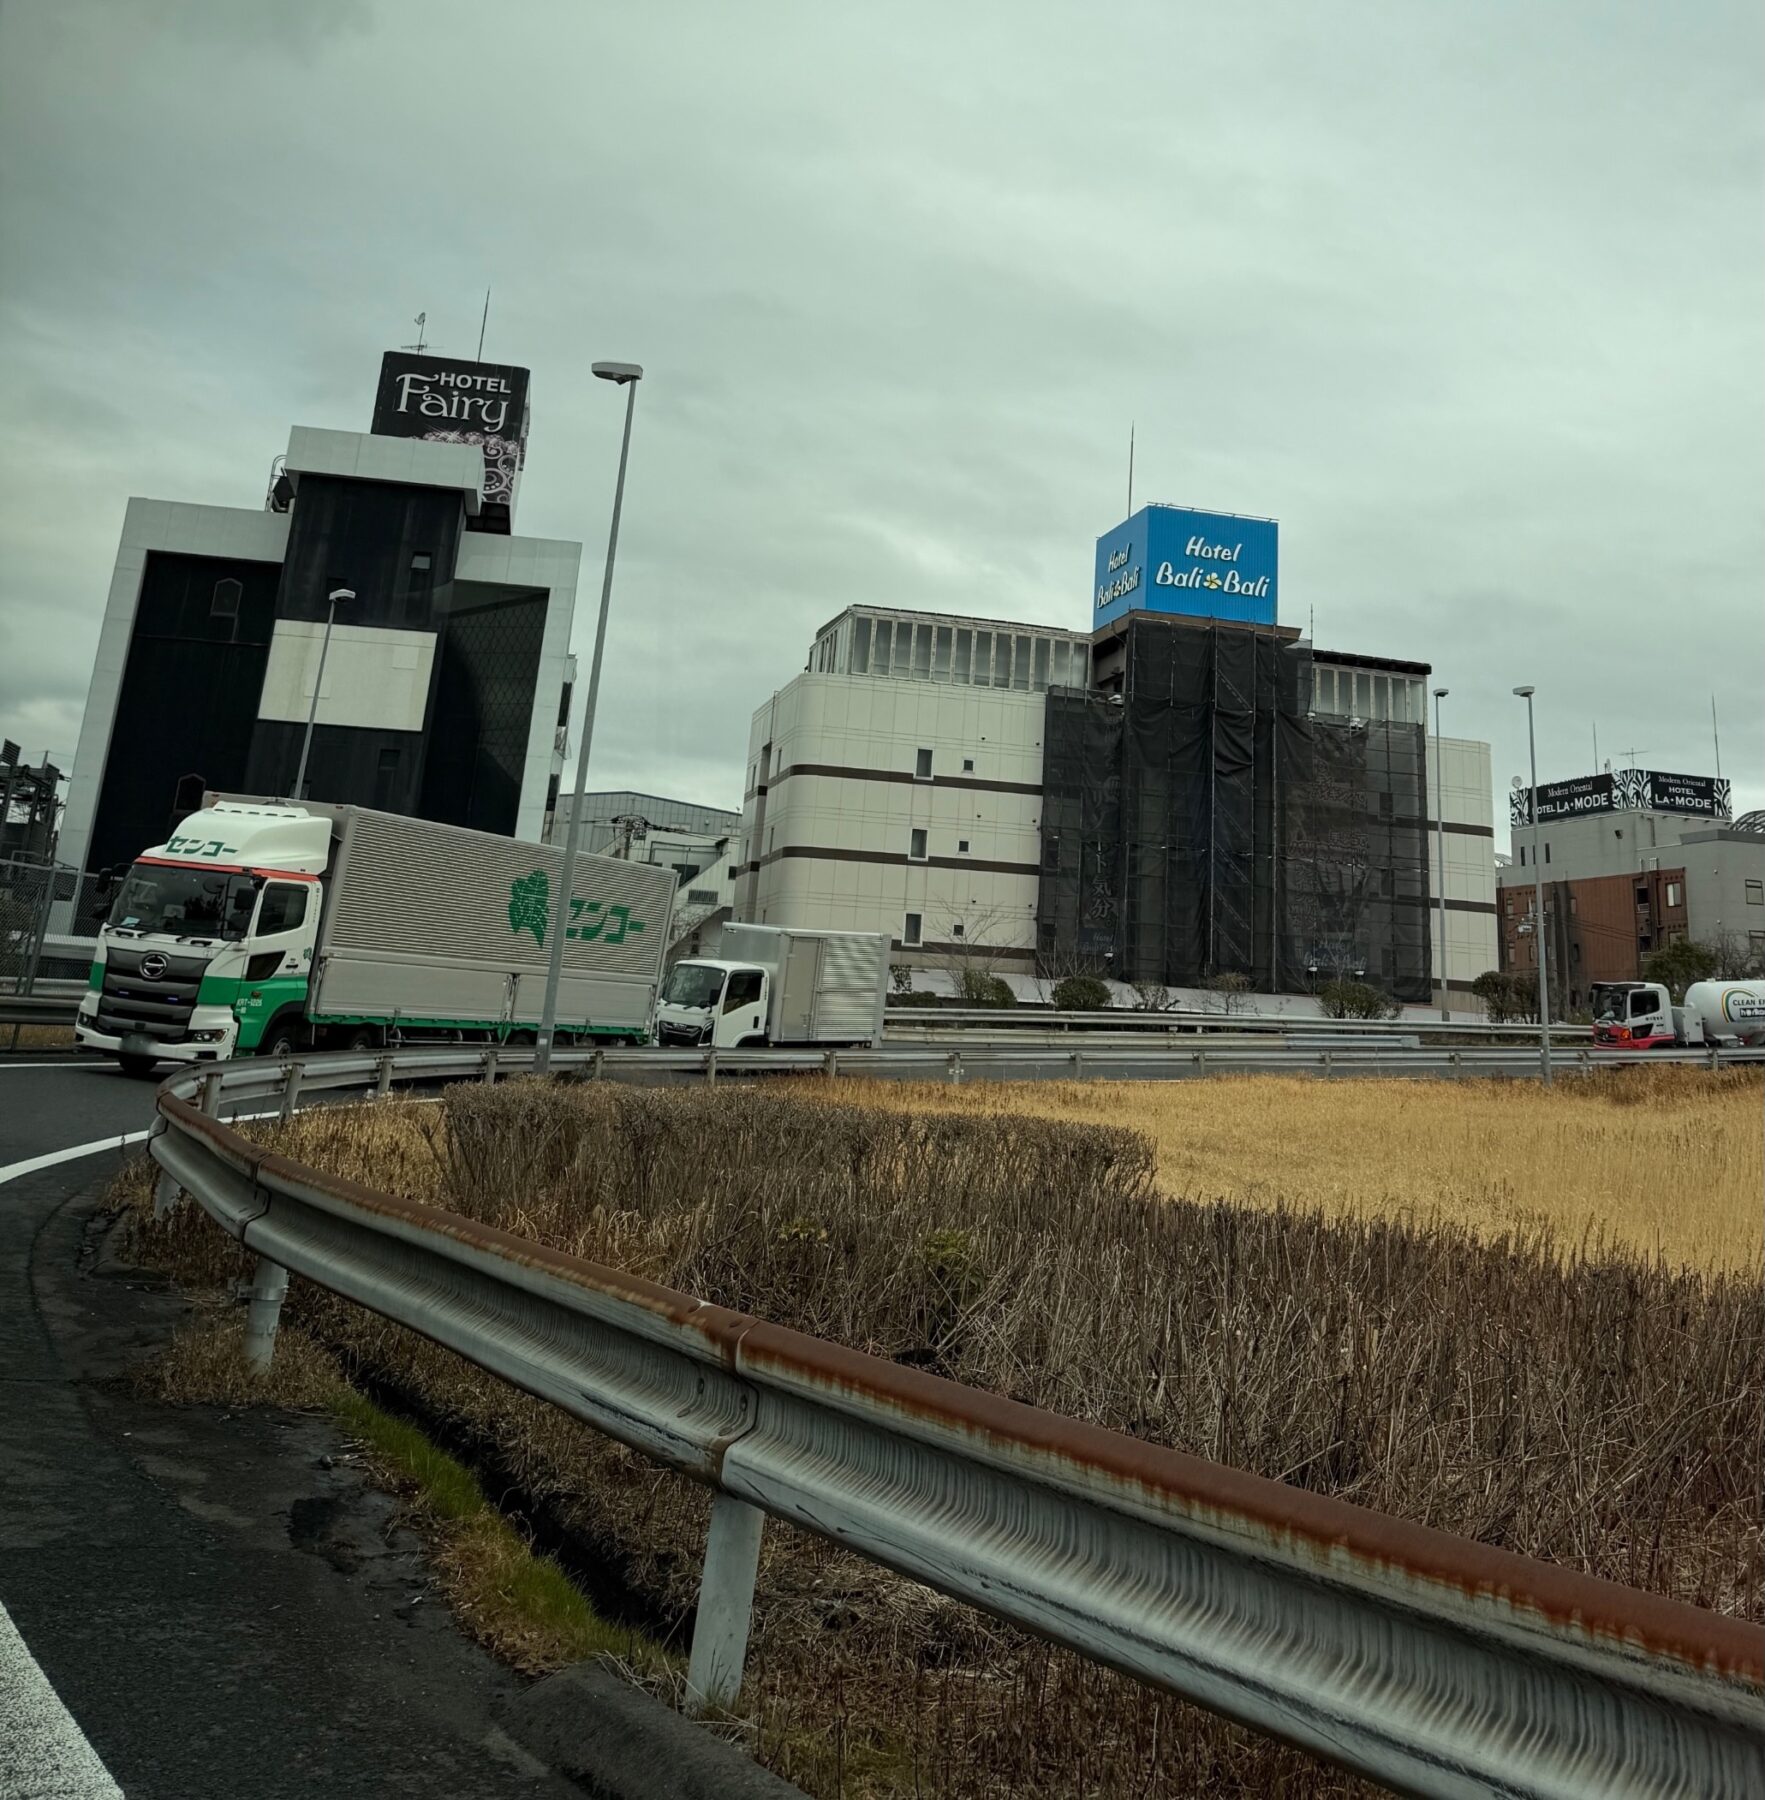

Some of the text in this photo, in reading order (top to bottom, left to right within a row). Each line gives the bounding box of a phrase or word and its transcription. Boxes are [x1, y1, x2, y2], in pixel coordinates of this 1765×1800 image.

[440, 372, 511, 393] HOTEL
[396, 373, 509, 432] Fairy
[1108, 543, 1131, 573] Hotel
[1185, 536, 1242, 562] Hotel
[1097, 566, 1141, 609] Bali Bali
[1156, 562, 1270, 597] Bali Bali
[1658, 775, 1706, 787] Modern Oriental
[1668, 786, 1696, 796] HOTEL
[1547, 786, 1569, 798] Modern
[1532, 804, 1555, 815] OTEL
[165, 836, 239, 857] センコー
[1732, 999, 1756, 1007] CLEAN
